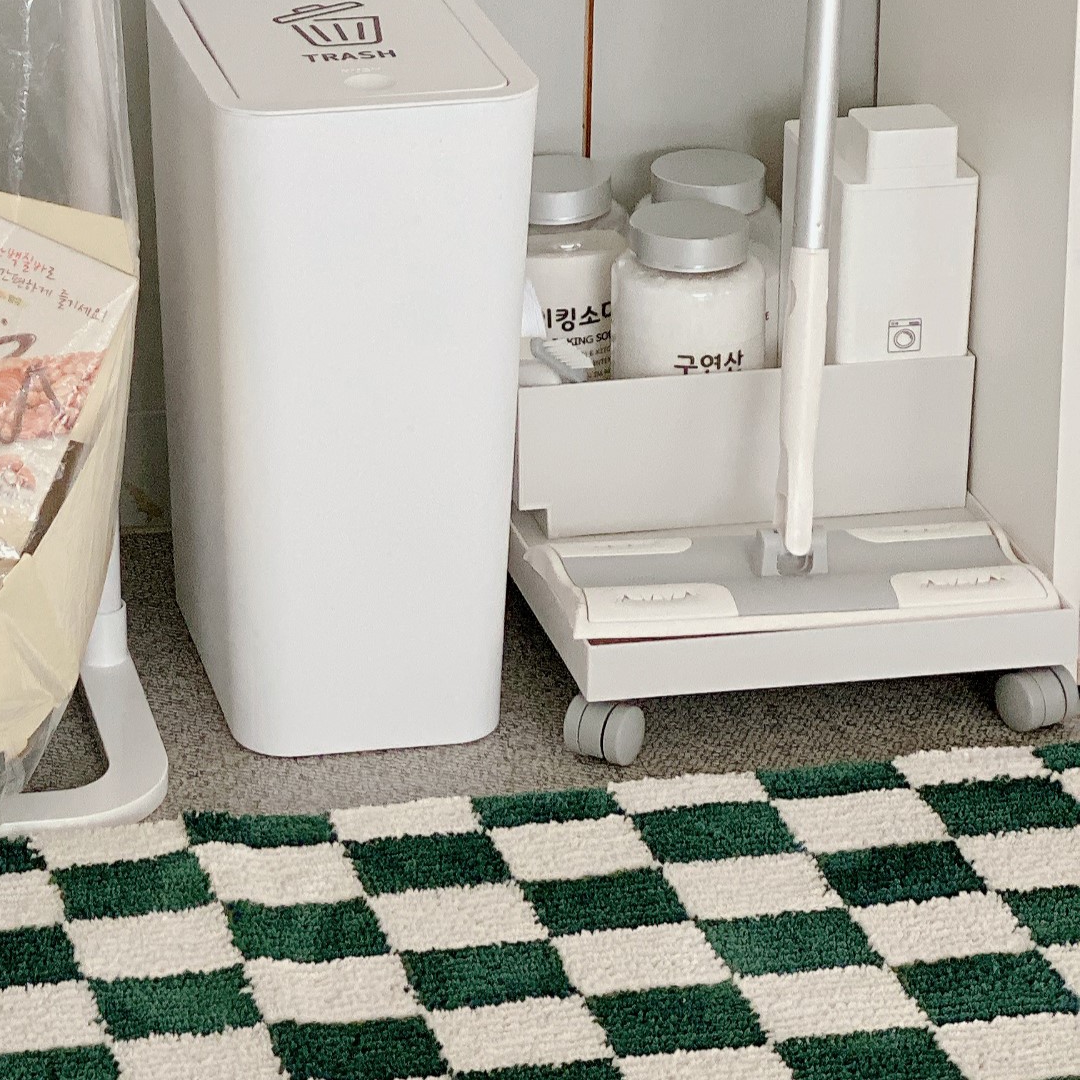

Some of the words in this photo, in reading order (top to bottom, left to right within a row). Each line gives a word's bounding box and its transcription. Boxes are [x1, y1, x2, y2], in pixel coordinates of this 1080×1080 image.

[302, 49, 397, 63] TRASH
[0, 266, 53, 298] 간편하게
[58, 288, 108, 323] 즐기세요!
[542, 300, 612, 332] 킹소
[674, 349, 744, 375] 구연산
